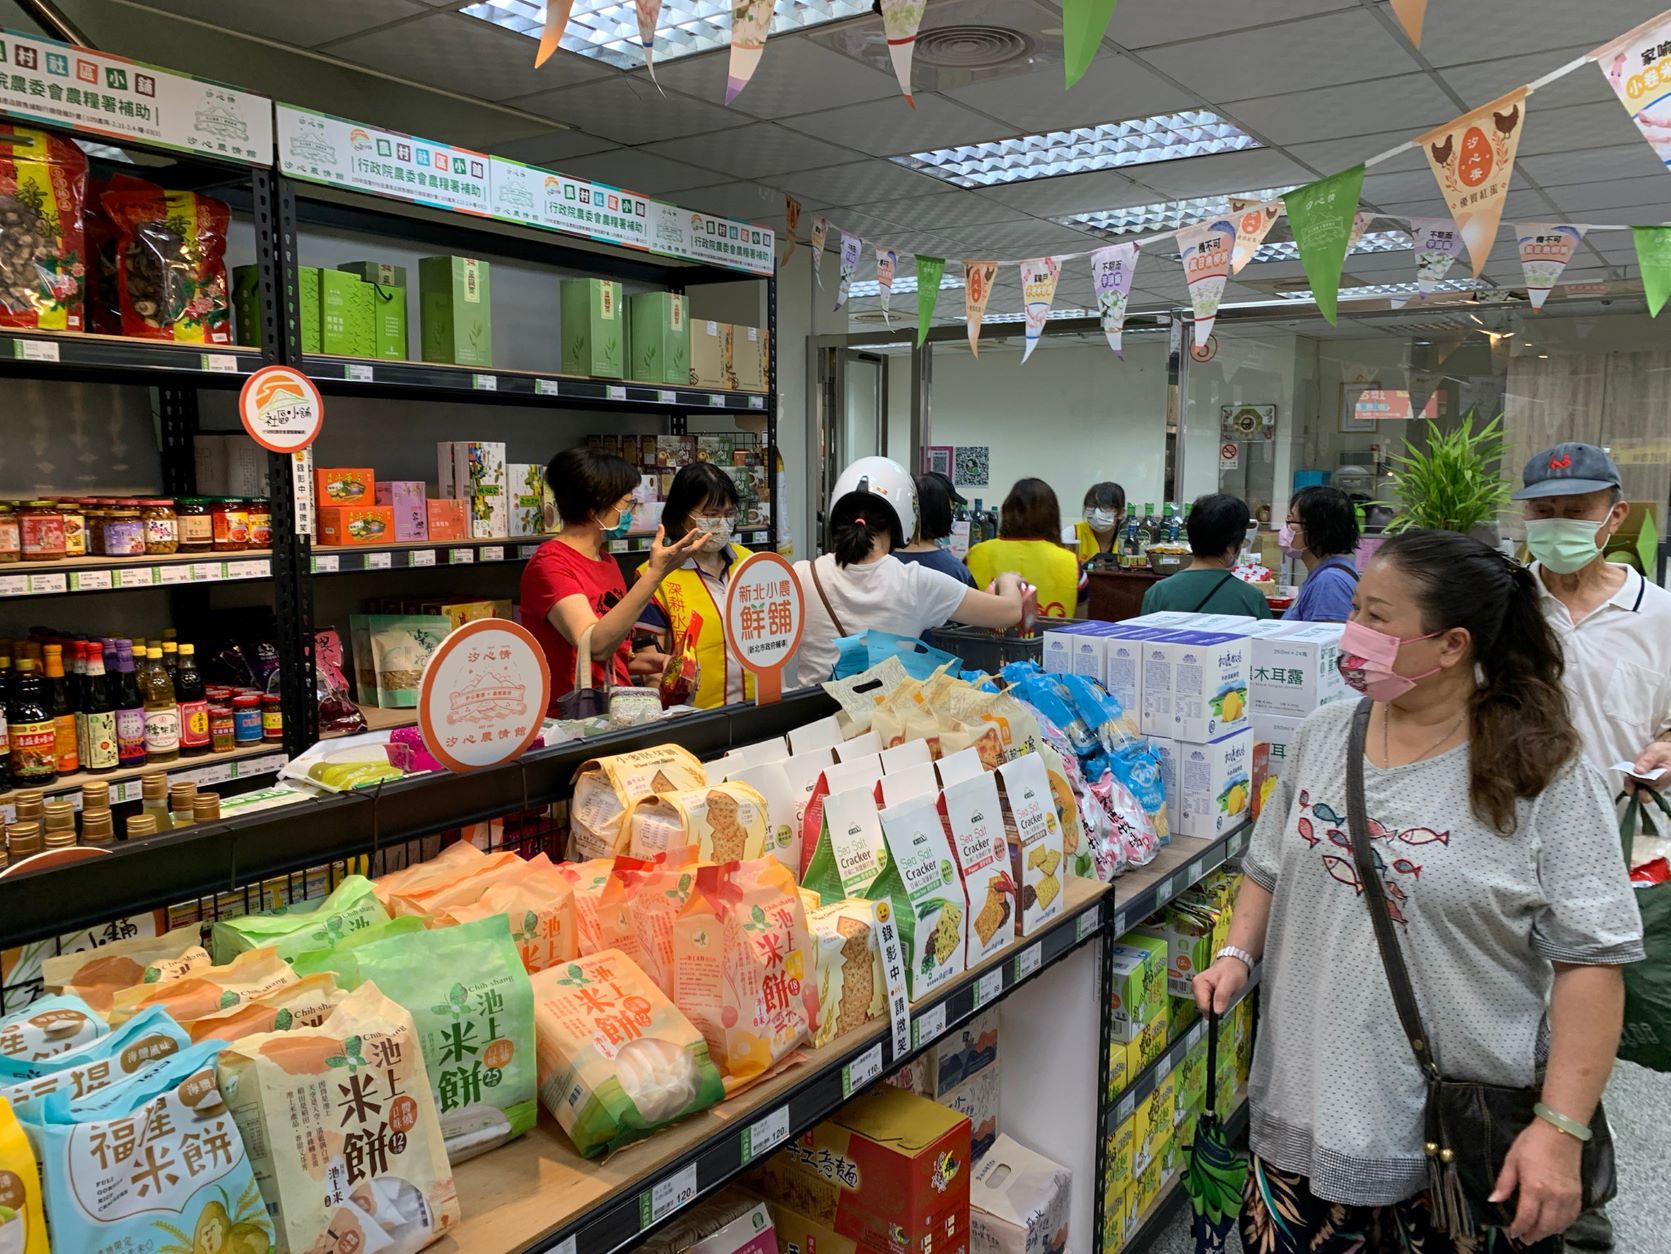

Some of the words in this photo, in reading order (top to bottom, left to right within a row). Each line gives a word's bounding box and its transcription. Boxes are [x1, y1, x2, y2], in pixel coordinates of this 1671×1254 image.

[0, 40, 155, 98] 村社區小舖
[357, 157, 482, 198] 行政院農委會農糧署補助
[549, 201, 643, 235] 行政院農委會農糧署補助
[694, 235, 769, 263] 行政院農委會農糧署補助
[738, 579, 791, 604] 新北小農
[740, 600, 793, 641] 鮮舖
[749, 640, 788, 656] 新北市政府輔導
[1250, 665, 1304, 686] 木耳露
[446, 726, 527, 748] 汐心農情館
[1020, 813, 1043, 830] Cracker
[837, 846, 851, 857] Sea
[959, 834, 973, 845] Sea
[963, 838, 990, 857] Cracker
[840, 850, 871, 869] Cracker
[900, 856, 918, 870] Sea
[917, 847, 934, 862] Salt
[905, 860, 937, 881] Cracker
[542, 915, 562, 965] 池上
[771, 908, 796, 954] 池上
[882, 924, 900, 981] 錄影中
[588, 965, 632, 1000] 池上
[755, 933, 790, 1015] 米餅
[789, 980, 798, 991] 18
[475, 988, 506, 1045] 池上
[573, 987, 643, 1047] 米餅
[635, 1012, 648, 1023] 12
[894, 998, 908, 1055] 請微笑
[127, 1041, 171, 1063] 海鹽風味
[370, 1038, 406, 1101] 池上
[438, 1021, 482, 1115] 米餅
[485, 1071, 499, 1082] 25
[337, 1073, 390, 1187] 米餅
[390, 1132, 403, 1147] 12
[131, 1121, 233, 1199] 米餅
[328, 1166, 344, 1204] 池上米
